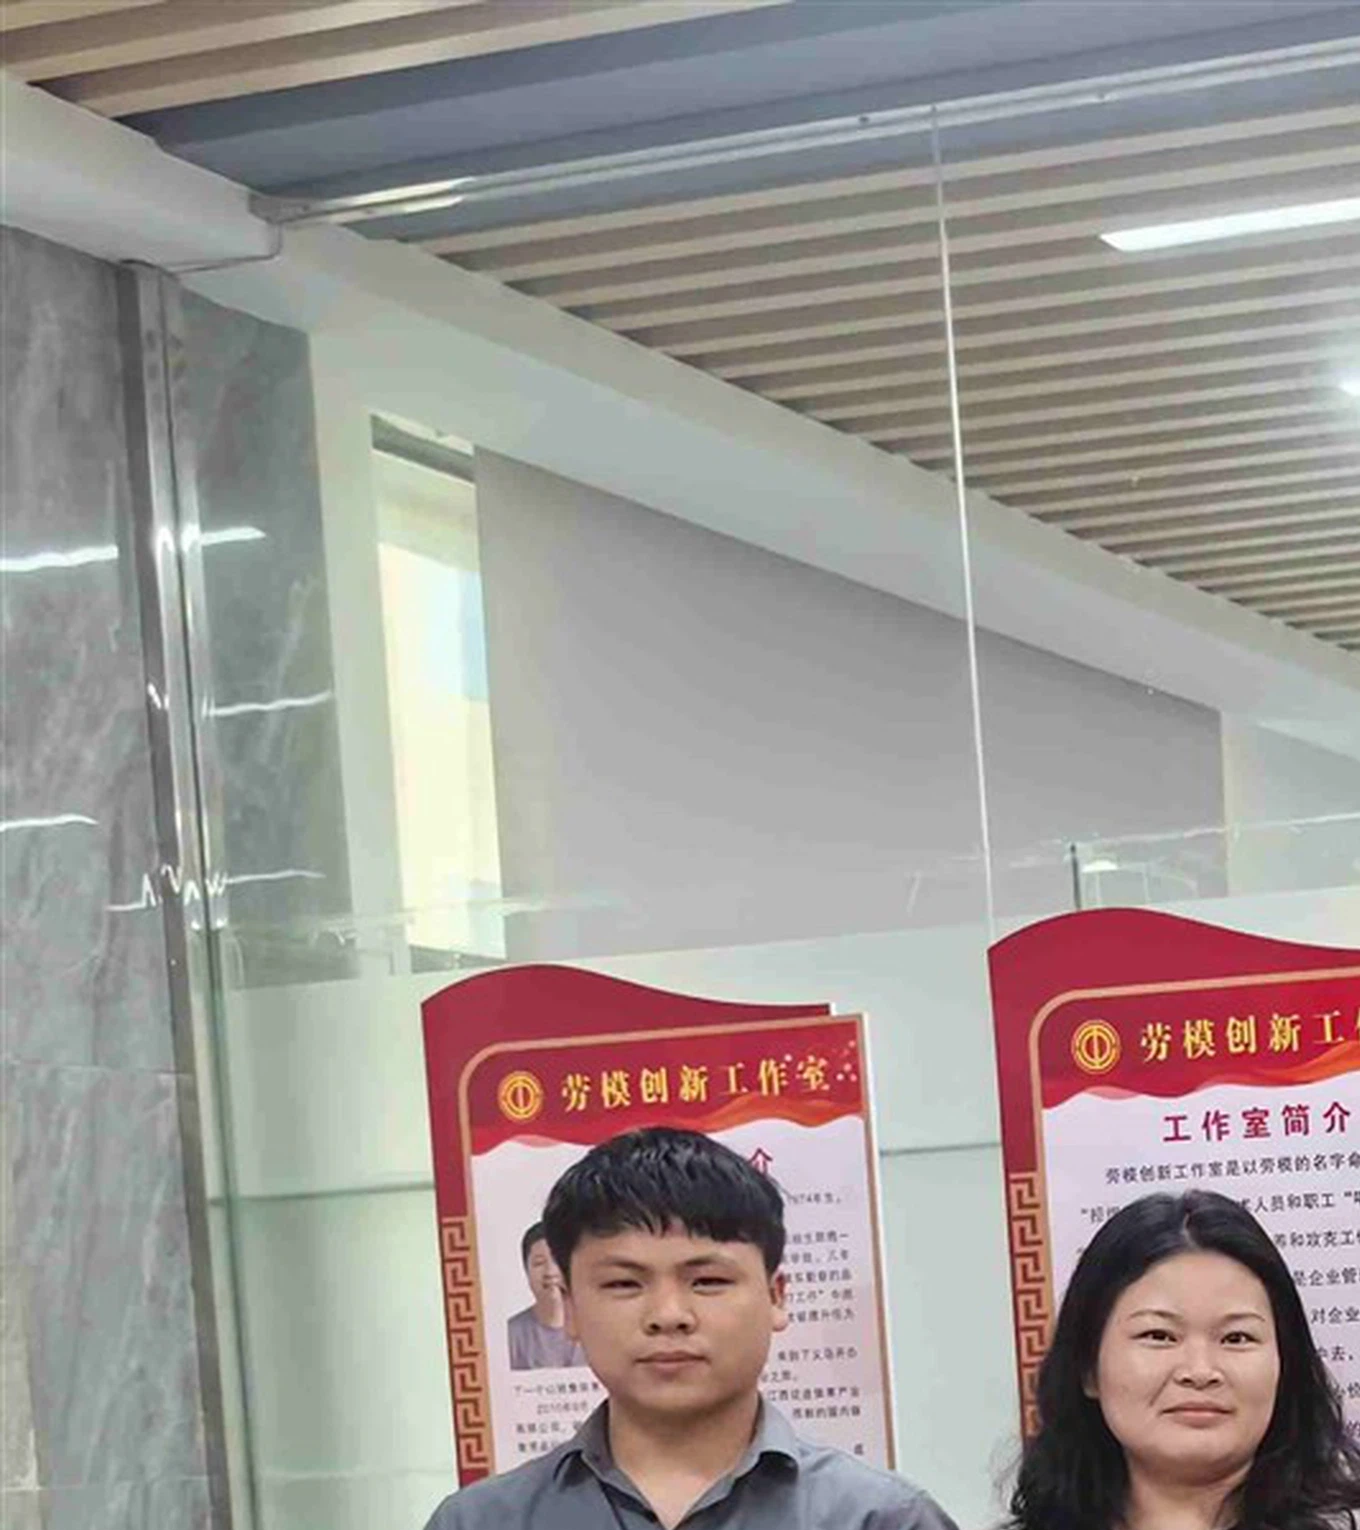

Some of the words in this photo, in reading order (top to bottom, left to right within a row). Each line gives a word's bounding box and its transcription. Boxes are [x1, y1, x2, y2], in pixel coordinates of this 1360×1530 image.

[562, 1056, 830, 1111] 劳模创新工作室
[1162, 1101, 1352, 1143] 工作室简介
